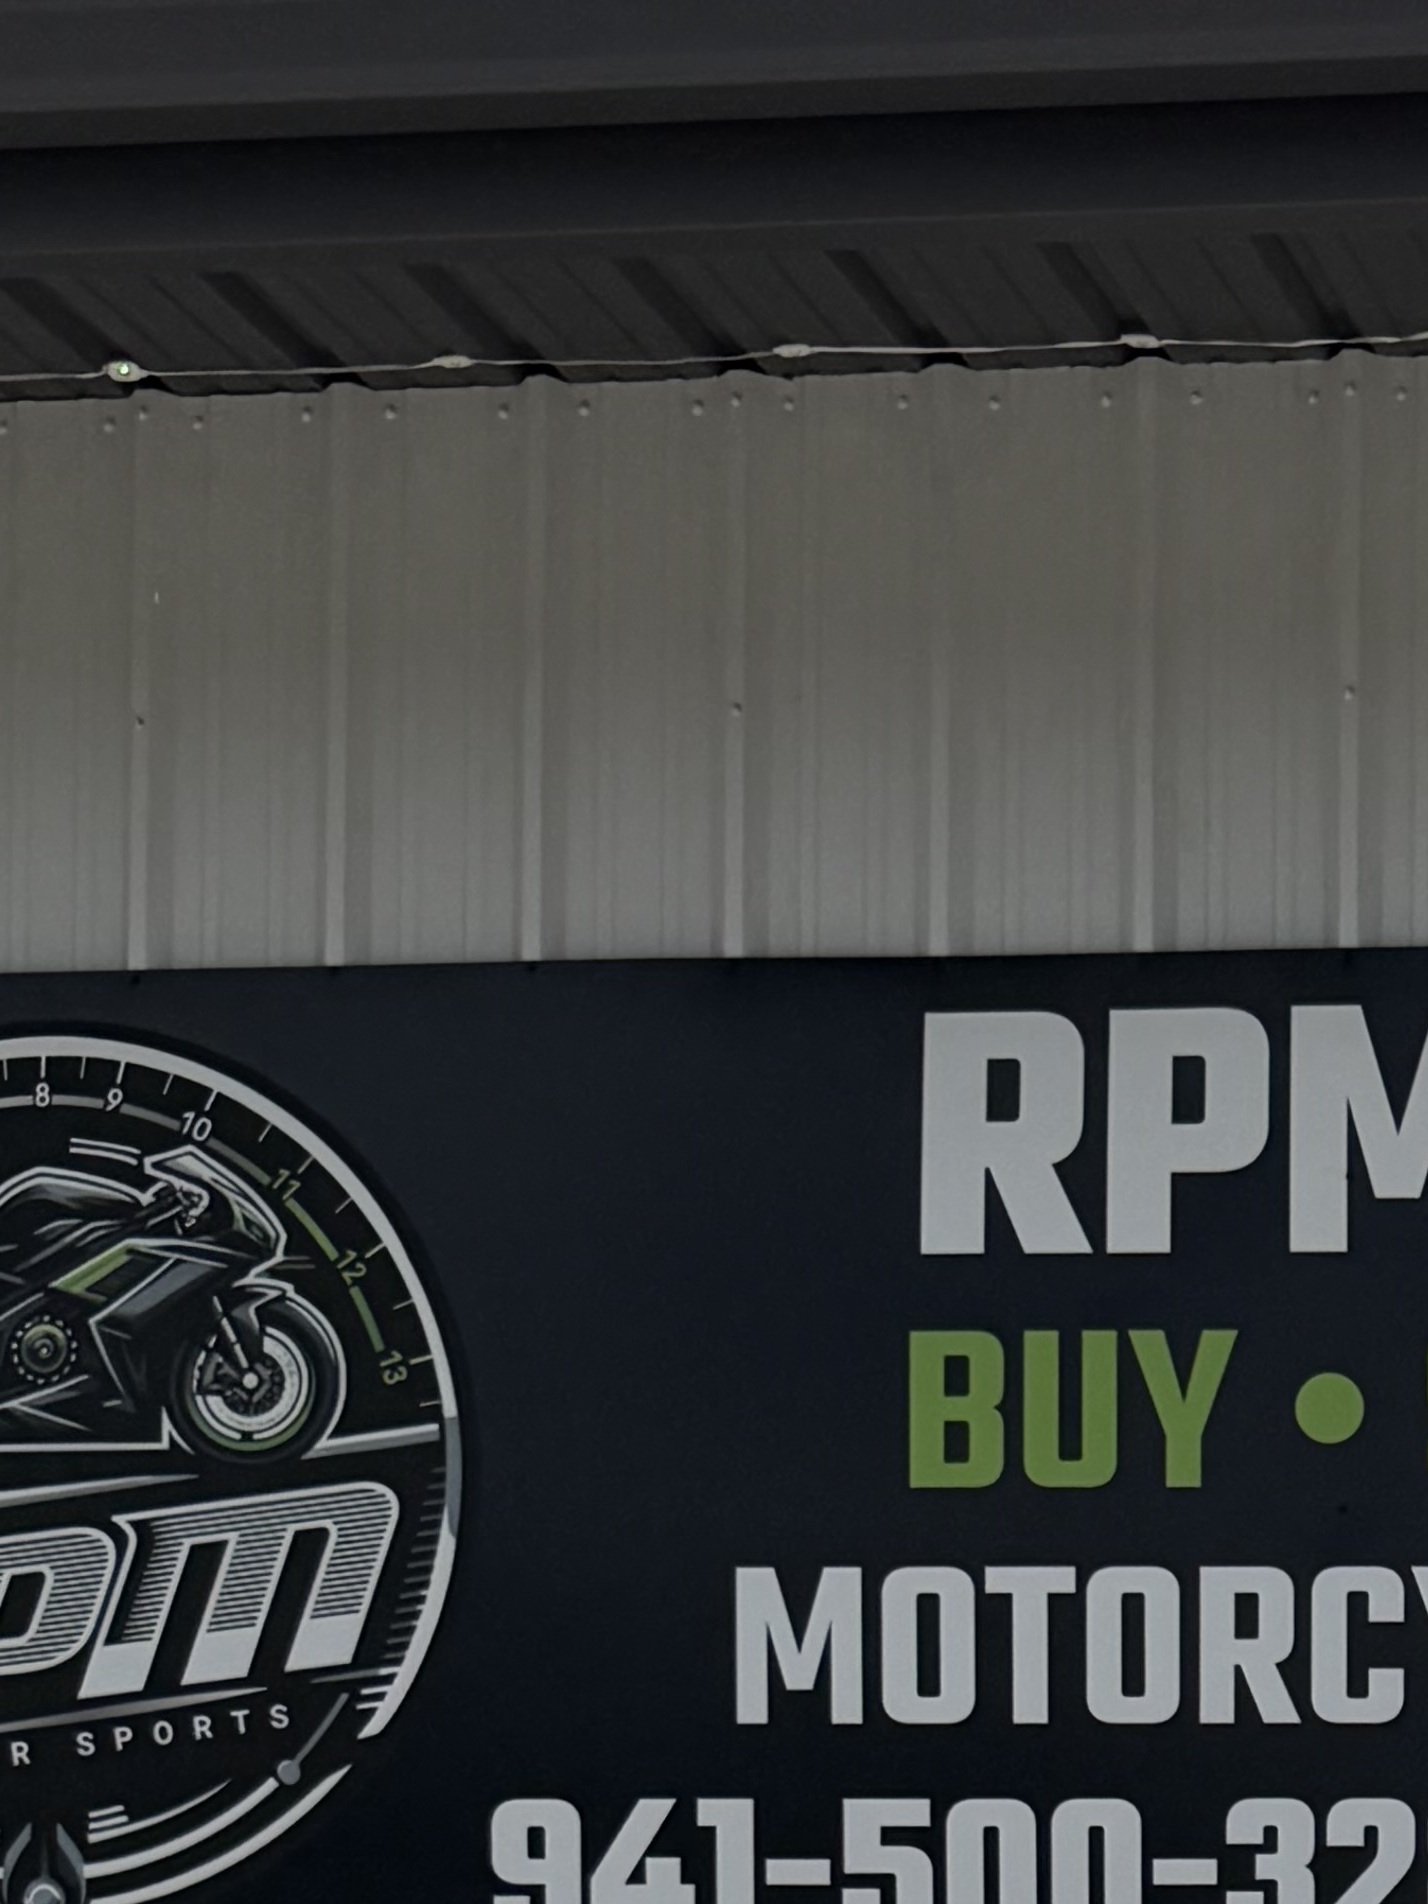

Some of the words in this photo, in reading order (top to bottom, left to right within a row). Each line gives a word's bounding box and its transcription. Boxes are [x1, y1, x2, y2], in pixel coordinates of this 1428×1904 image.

[35, 1083, 51, 1107] 8
[105, 1087, 124, 1112] 9
[181, 1110, 212, 1142] 10
[272, 1168, 301, 1201] 11
[337, 1248, 367, 1287] 12
[379, 1349, 408, 1386] 13
[910, 1330, 1237, 1488] BUY
[75, 1704, 290, 1756] SPORTS
